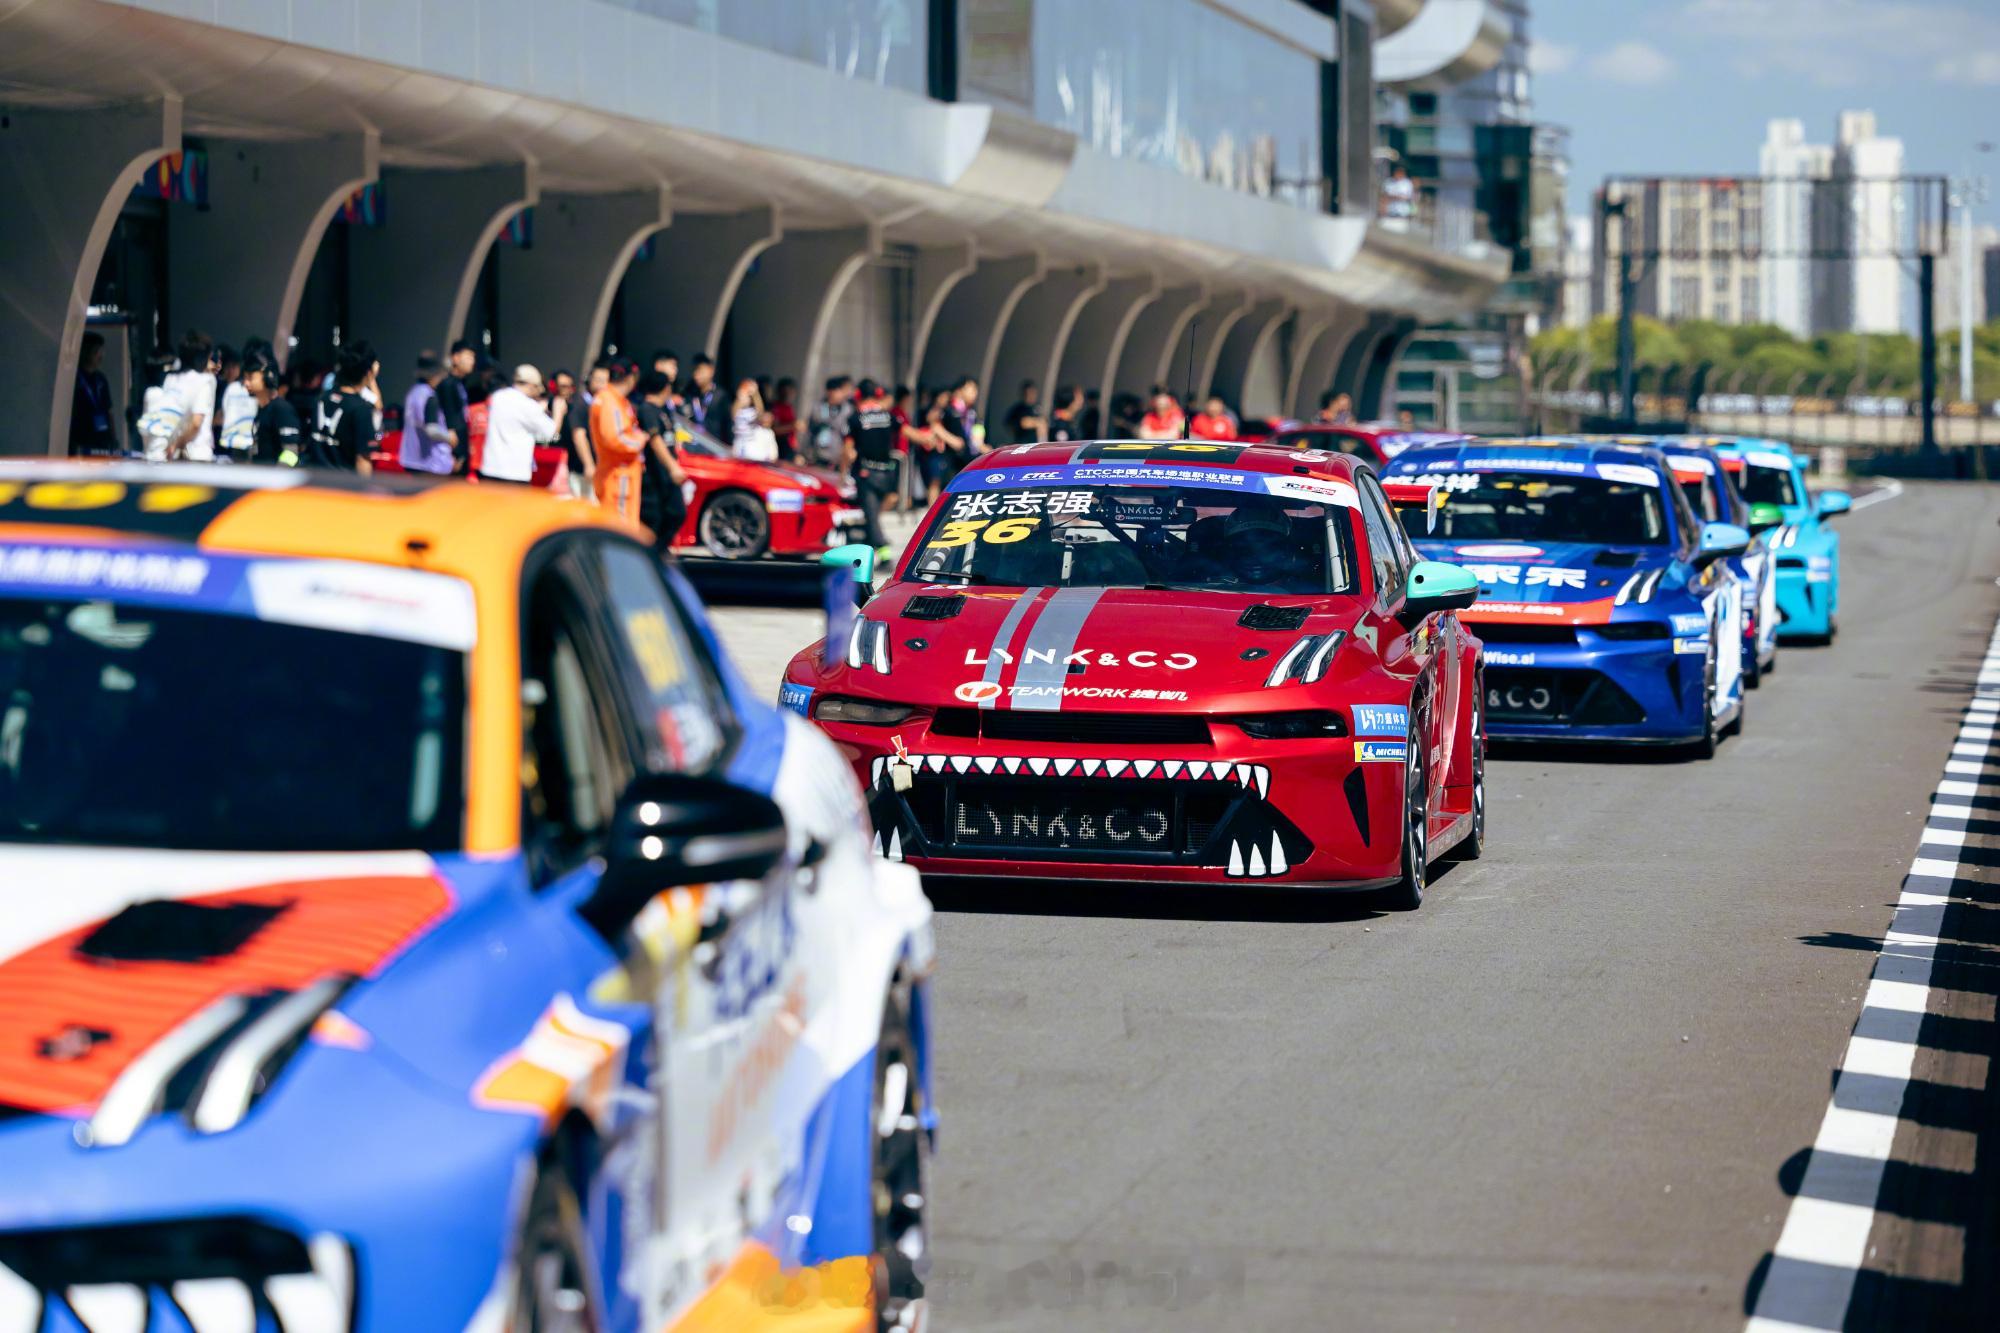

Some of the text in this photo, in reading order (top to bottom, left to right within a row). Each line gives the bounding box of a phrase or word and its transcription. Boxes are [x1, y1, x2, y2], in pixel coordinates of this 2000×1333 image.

[951, 491, 1094, 519] 张志强
[926, 517, 1042, 549] 36
[1007, 686, 1129, 700] TEAMWORK
[1376, 748, 1407, 756] MICHELI
